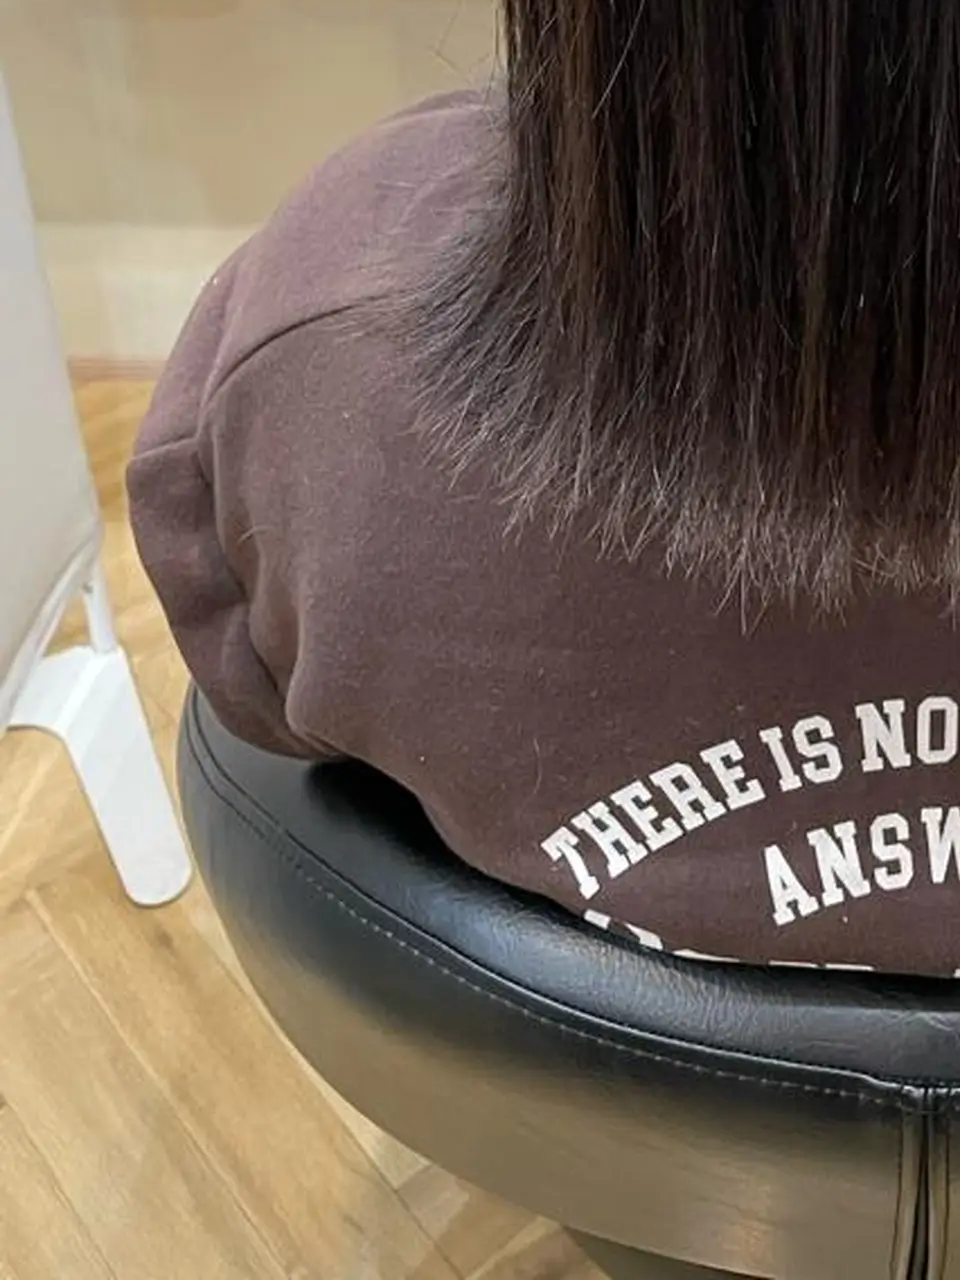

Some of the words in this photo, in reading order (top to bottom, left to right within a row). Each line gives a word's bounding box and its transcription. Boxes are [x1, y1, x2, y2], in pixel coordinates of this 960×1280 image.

[540, 739, 766, 900] THERE
[759, 715, 843, 792] IS
[855, 696, 958, 773] NO
